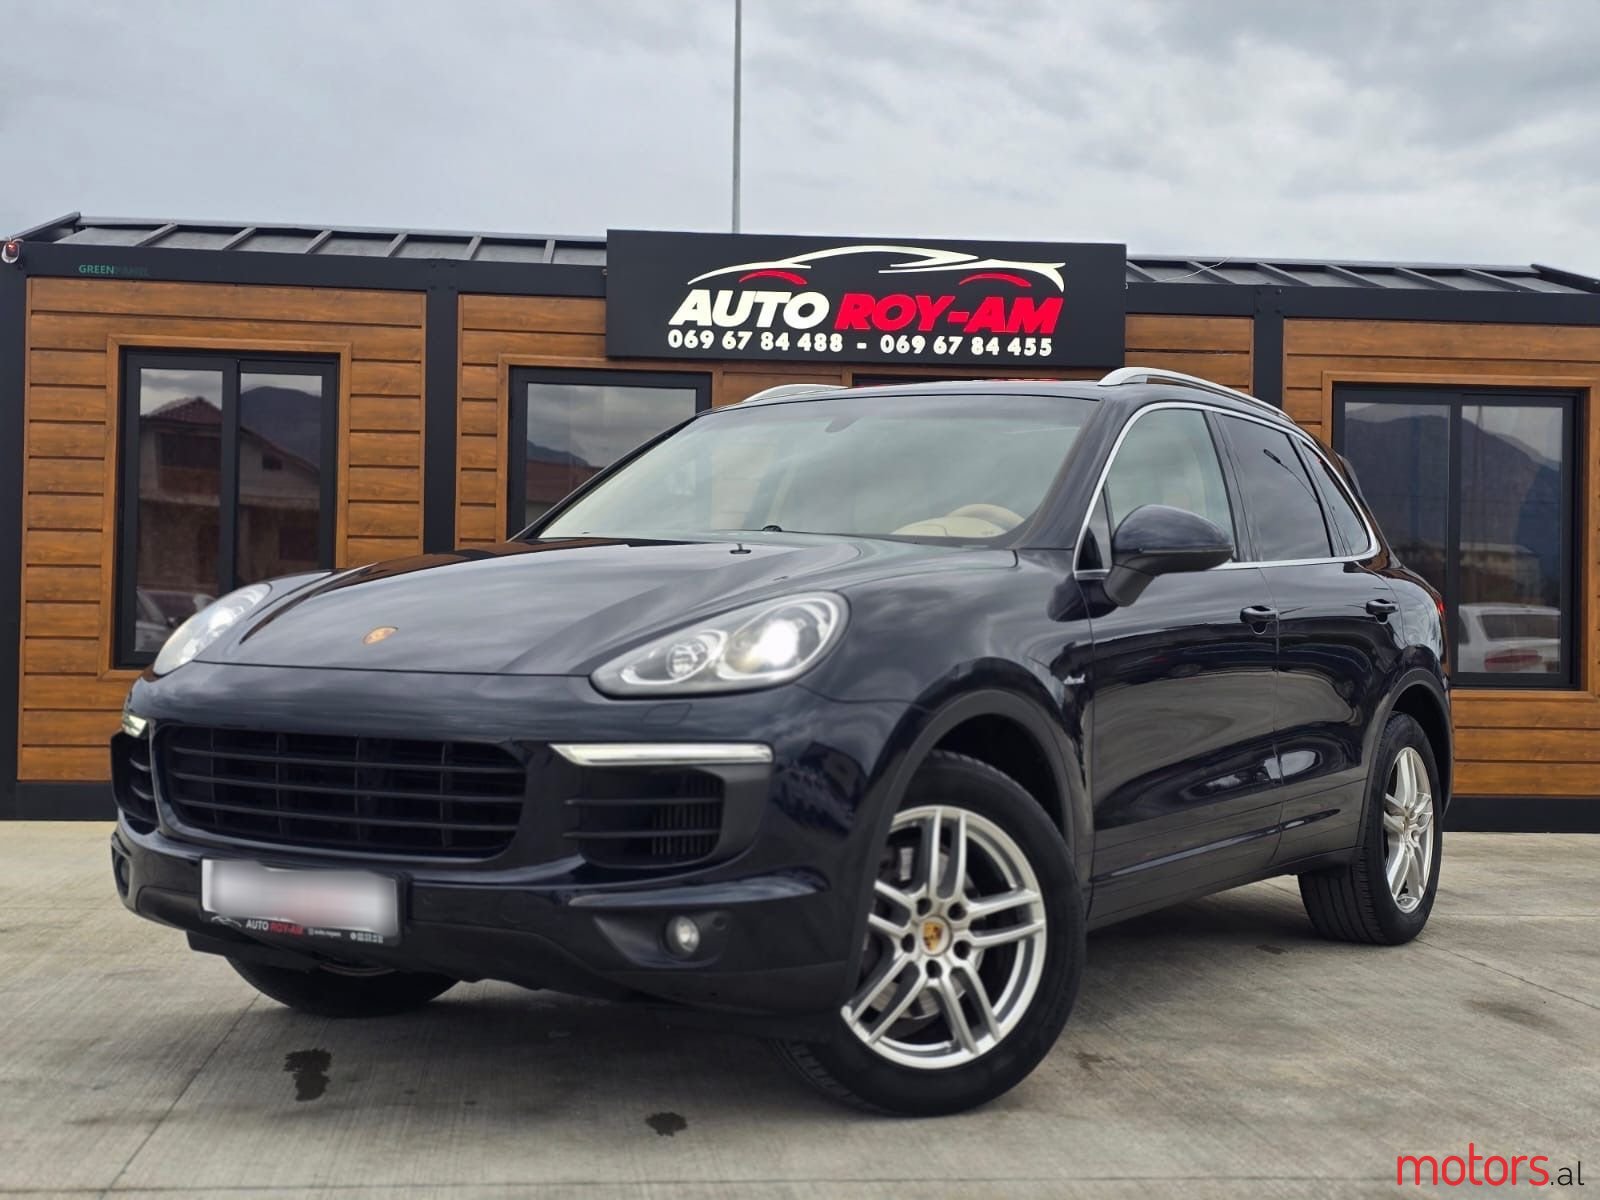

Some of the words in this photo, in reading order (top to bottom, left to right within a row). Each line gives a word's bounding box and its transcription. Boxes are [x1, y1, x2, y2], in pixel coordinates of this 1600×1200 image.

[668, 288, 830, 330] AUTO
[834, 293, 1064, 335] ROY-AM
[667, 328, 715, 350] 069
[721, 330, 753, 351] 67
[760, 331, 792, 352] 84
[796, 332, 843, 353] 488
[879, 334, 926, 354] 069
[932, 335, 964, 355] 67
[970, 336, 1000, 356] 84
[1006, 337, 1052, 357] 455
[245, 919, 269, 932] AUTO
